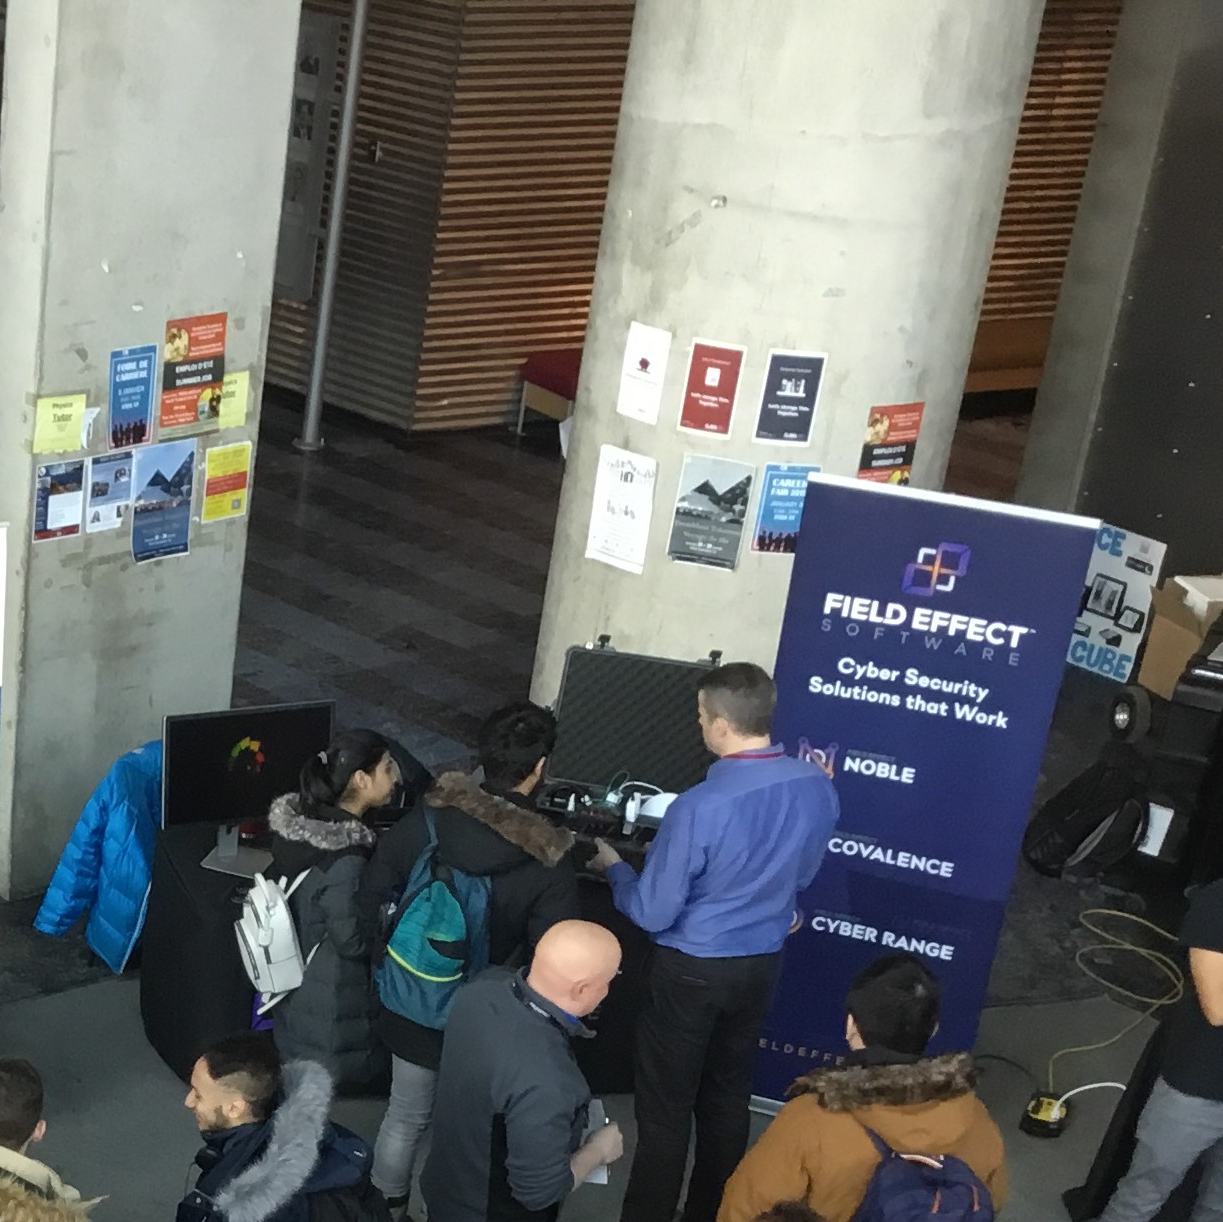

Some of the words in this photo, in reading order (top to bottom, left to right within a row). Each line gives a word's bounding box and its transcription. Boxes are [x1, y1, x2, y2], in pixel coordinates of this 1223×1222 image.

[1096, 527, 1127, 558] CE
[823, 592, 908, 626] FIELD
[911, 607, 1030, 649] EFFECT
[837, 656, 900, 680] Cyber
[904, 667, 990, 703] Security
[1070, 639, 1133, 681] CUBE
[808, 675, 902, 707] Solutions
[905, 694, 949, 717] that
[953, 702, 1009, 729] Work
[843, 756, 916, 784] NOBLE
[828, 837, 955, 878] COVALENCE
[811, 916, 879, 943] CYBER
[882, 931, 955, 961] RANGE
